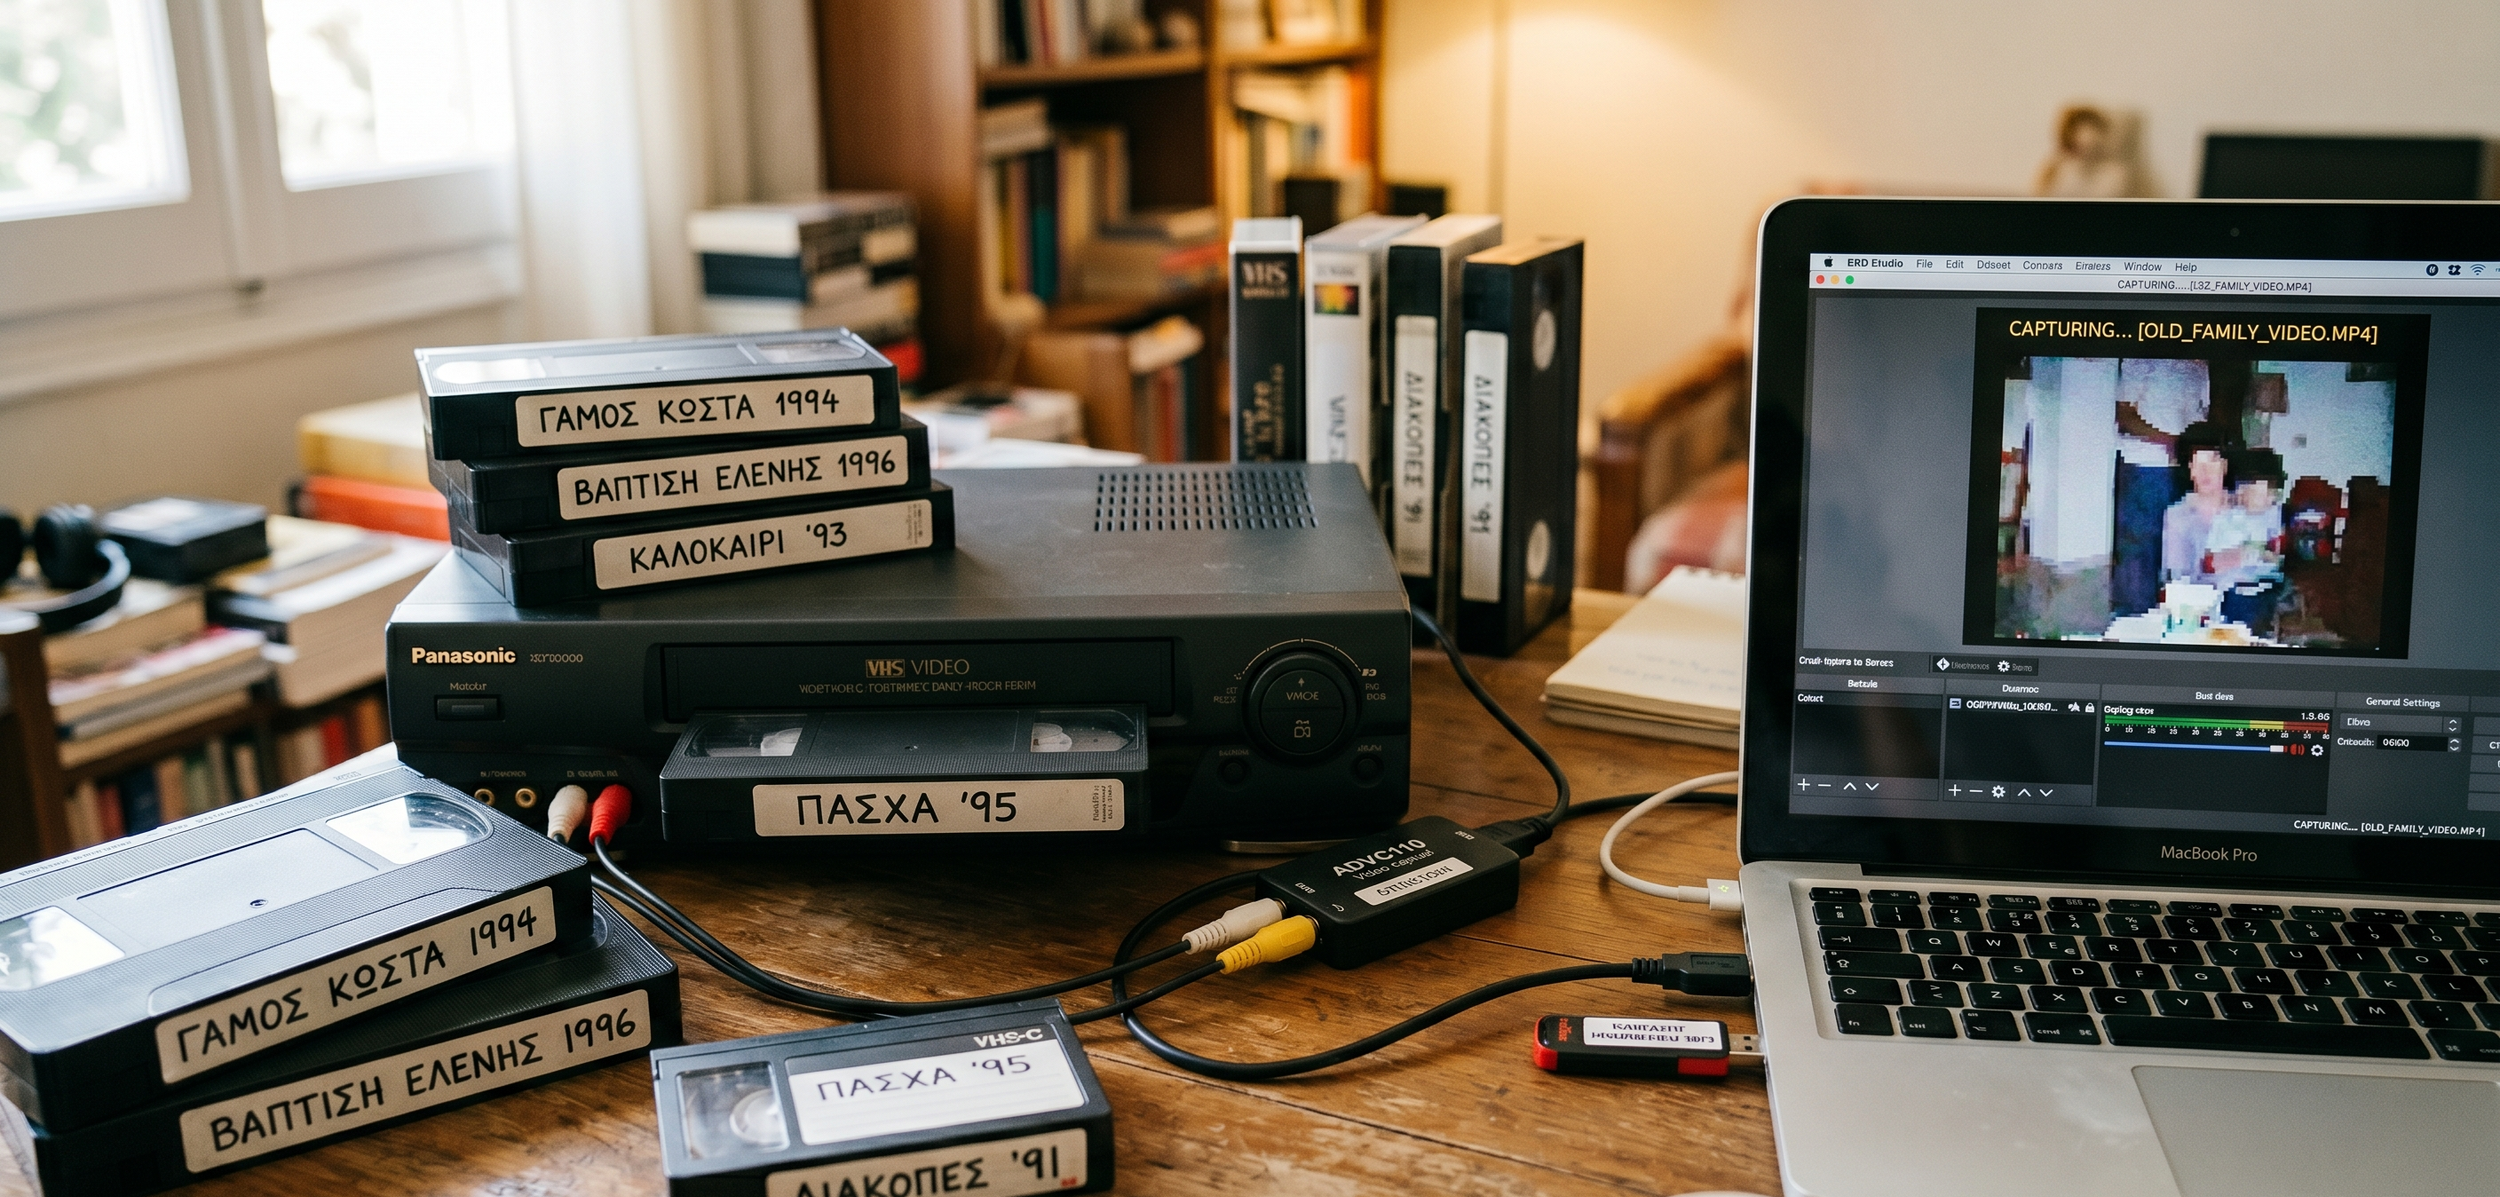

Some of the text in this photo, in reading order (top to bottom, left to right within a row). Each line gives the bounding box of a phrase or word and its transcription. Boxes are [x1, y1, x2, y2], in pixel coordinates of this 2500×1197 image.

[1848, 259, 1868, 267] ERD
[1917, 259, 1932, 268] File
[1947, 260, 1963, 268] Edit
[2124, 263, 2162, 271] Window
[2176, 263, 2197, 273] Help
[2009, 320, 2378, 345] CAPTURING... [OLD_FAMILY_VIDEO.MP4]
[540, 389, 839, 432] ΓΑΜΟΣ ΚΩΣΤΑ 1994
[575, 450, 895, 505] ΒΑΠΤΙΣΗ ΕΛΕΝΗΣ 1996
[630, 522, 847, 573] ΚΑΛΟΚΑΙΡΙ '93
[412, 647, 515, 663] Panasonic
[867, 659, 970, 677] VHS VIDEO
[2403, 698, 2441, 709] Settings
[797, 791, 1016, 825] ΠΑΣΧΑ '95
[1332, 839, 1427, 877] ADVC110
[2161, 846, 2258, 862] MacBook Pro
[176, 906, 538, 1063] ΓΑΜΟΣ ΚΩΣΤΑ 1994
[2320, 978, 2331, 986] J
[974, 1028, 1043, 1048] VHS-C
[210, 1008, 635, 1153] ΒΑΠΤΙΣΗ ΕΛΕΝΗΣ 1996
[818, 1056, 1030, 1100] ΠΑΣΧΑ '95
[1011, 1147, 1060, 1180] '91
